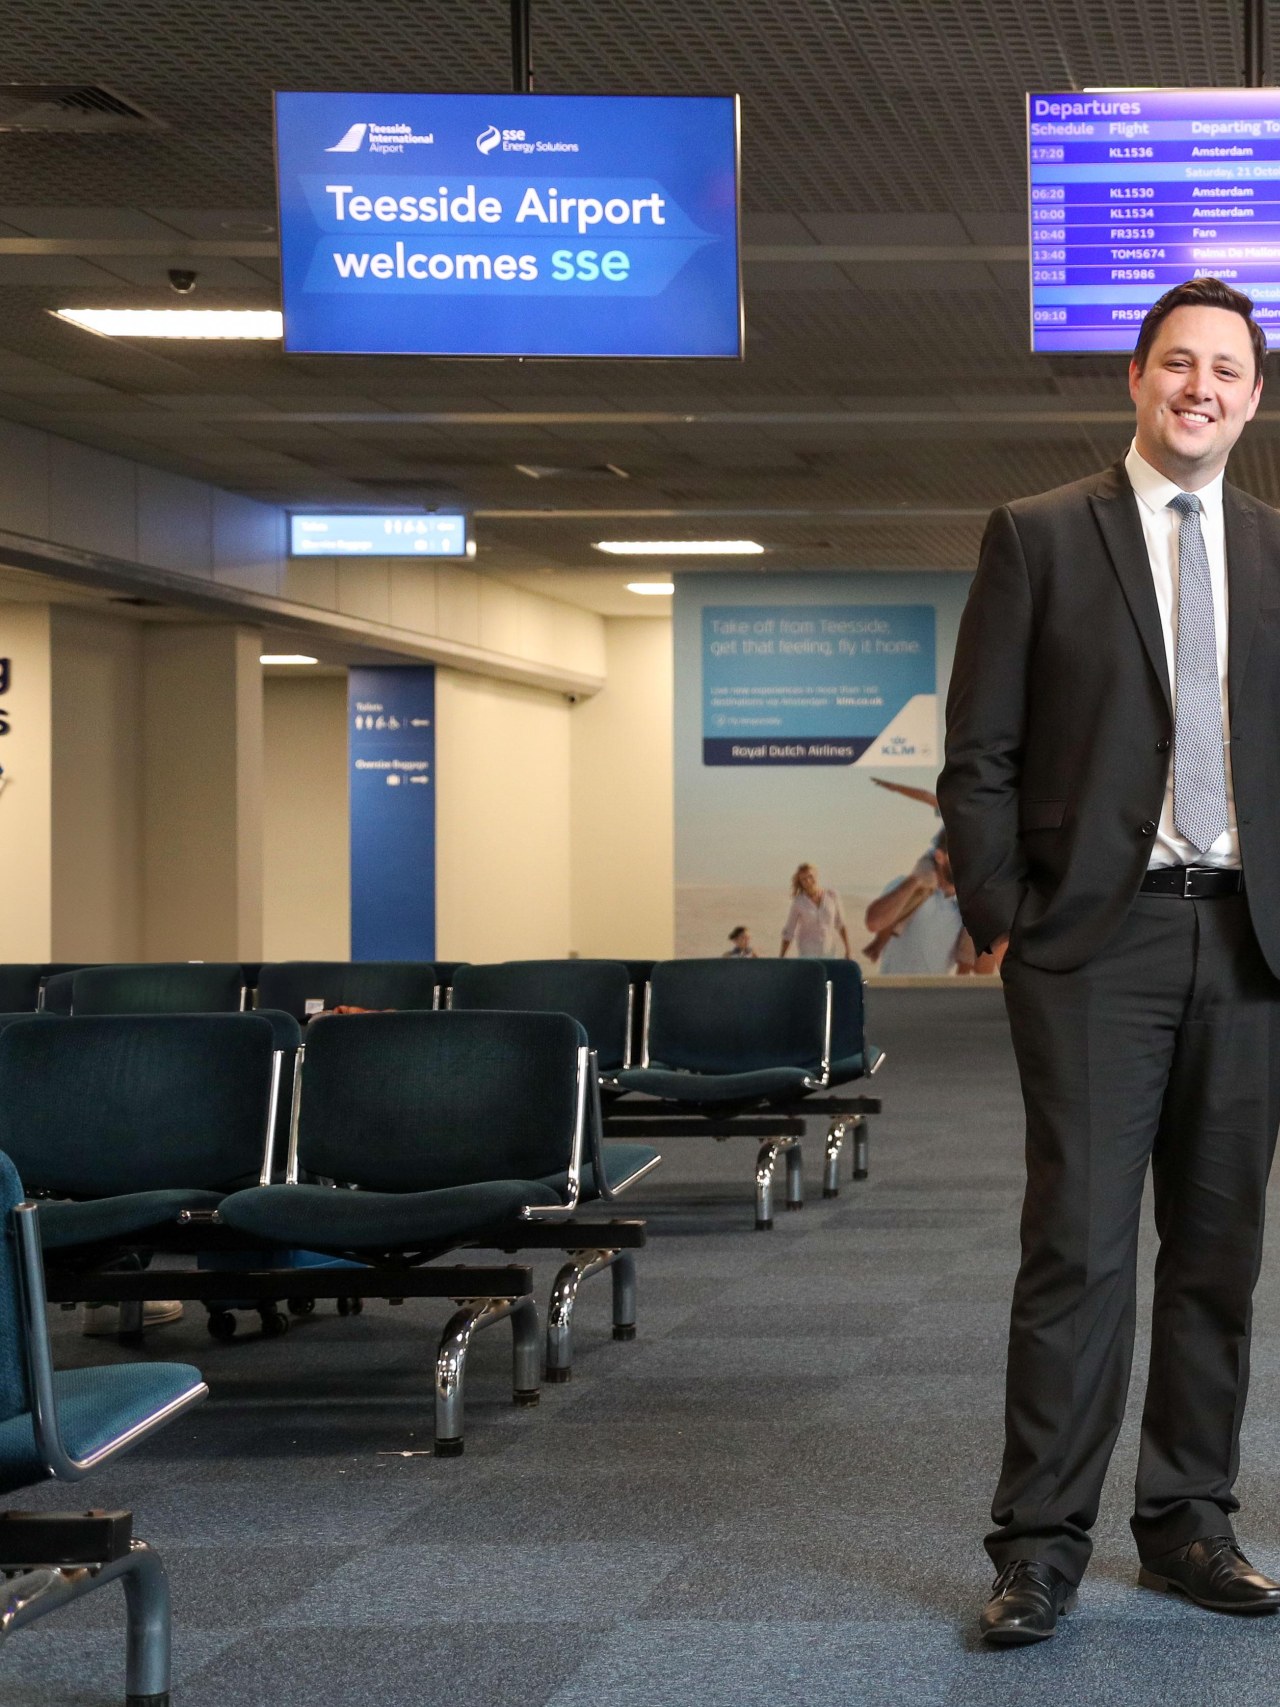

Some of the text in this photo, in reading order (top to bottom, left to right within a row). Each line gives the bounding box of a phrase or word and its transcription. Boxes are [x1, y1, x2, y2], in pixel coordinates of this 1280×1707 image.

[1034, 100, 1141, 119] Departures
[368, 123, 412, 134] Teesside
[502, 129, 526, 141] sse
[1031, 122, 1094, 136] Schedule
[1109, 122, 1149, 138] Flight
[1191, 121, 1261, 137] Departing
[1263, 120, 1280, 133] To
[368, 133, 434, 144] International
[368, 143, 405, 155] Airport
[502, 142, 580, 154] Energy Solutions
[1032, 148, 1065, 160] 17:20
[1109, 147, 1154, 158] KL1536
[1191, 146, 1253, 157] Amsterdam
[1236, 166, 1252, 177] 21
[1032, 187, 1254, 200] 06:20 KL1530 Amsterdam
[325, 184, 667, 234] Teesside Airport
[1033, 207, 1254, 221] 10:00 KL1534 Amsterdam
[1033, 227, 1217, 241] 10:40 FR3519 Faro
[333, 240, 631, 282] welcomes sse
[1033, 250, 1066, 261] 13:40
[1111, 248, 1166, 260] TOM5674
[1192, 247, 1226, 259] Palma
[1228, 247, 1243, 259] De
[1033, 268, 1238, 282] 20:15 FR5986 Alicante
[1034, 310, 1067, 322] 09:10
[711, 619, 749, 635] Take
[752, 619, 775, 635] off
[779, 619, 815, 635] from
[711, 639, 738, 657] get
[742, 638, 775, 655] that
[731, 744, 854, 760] Royal Dutch Airlines
[880, 745, 916, 756] KLM
